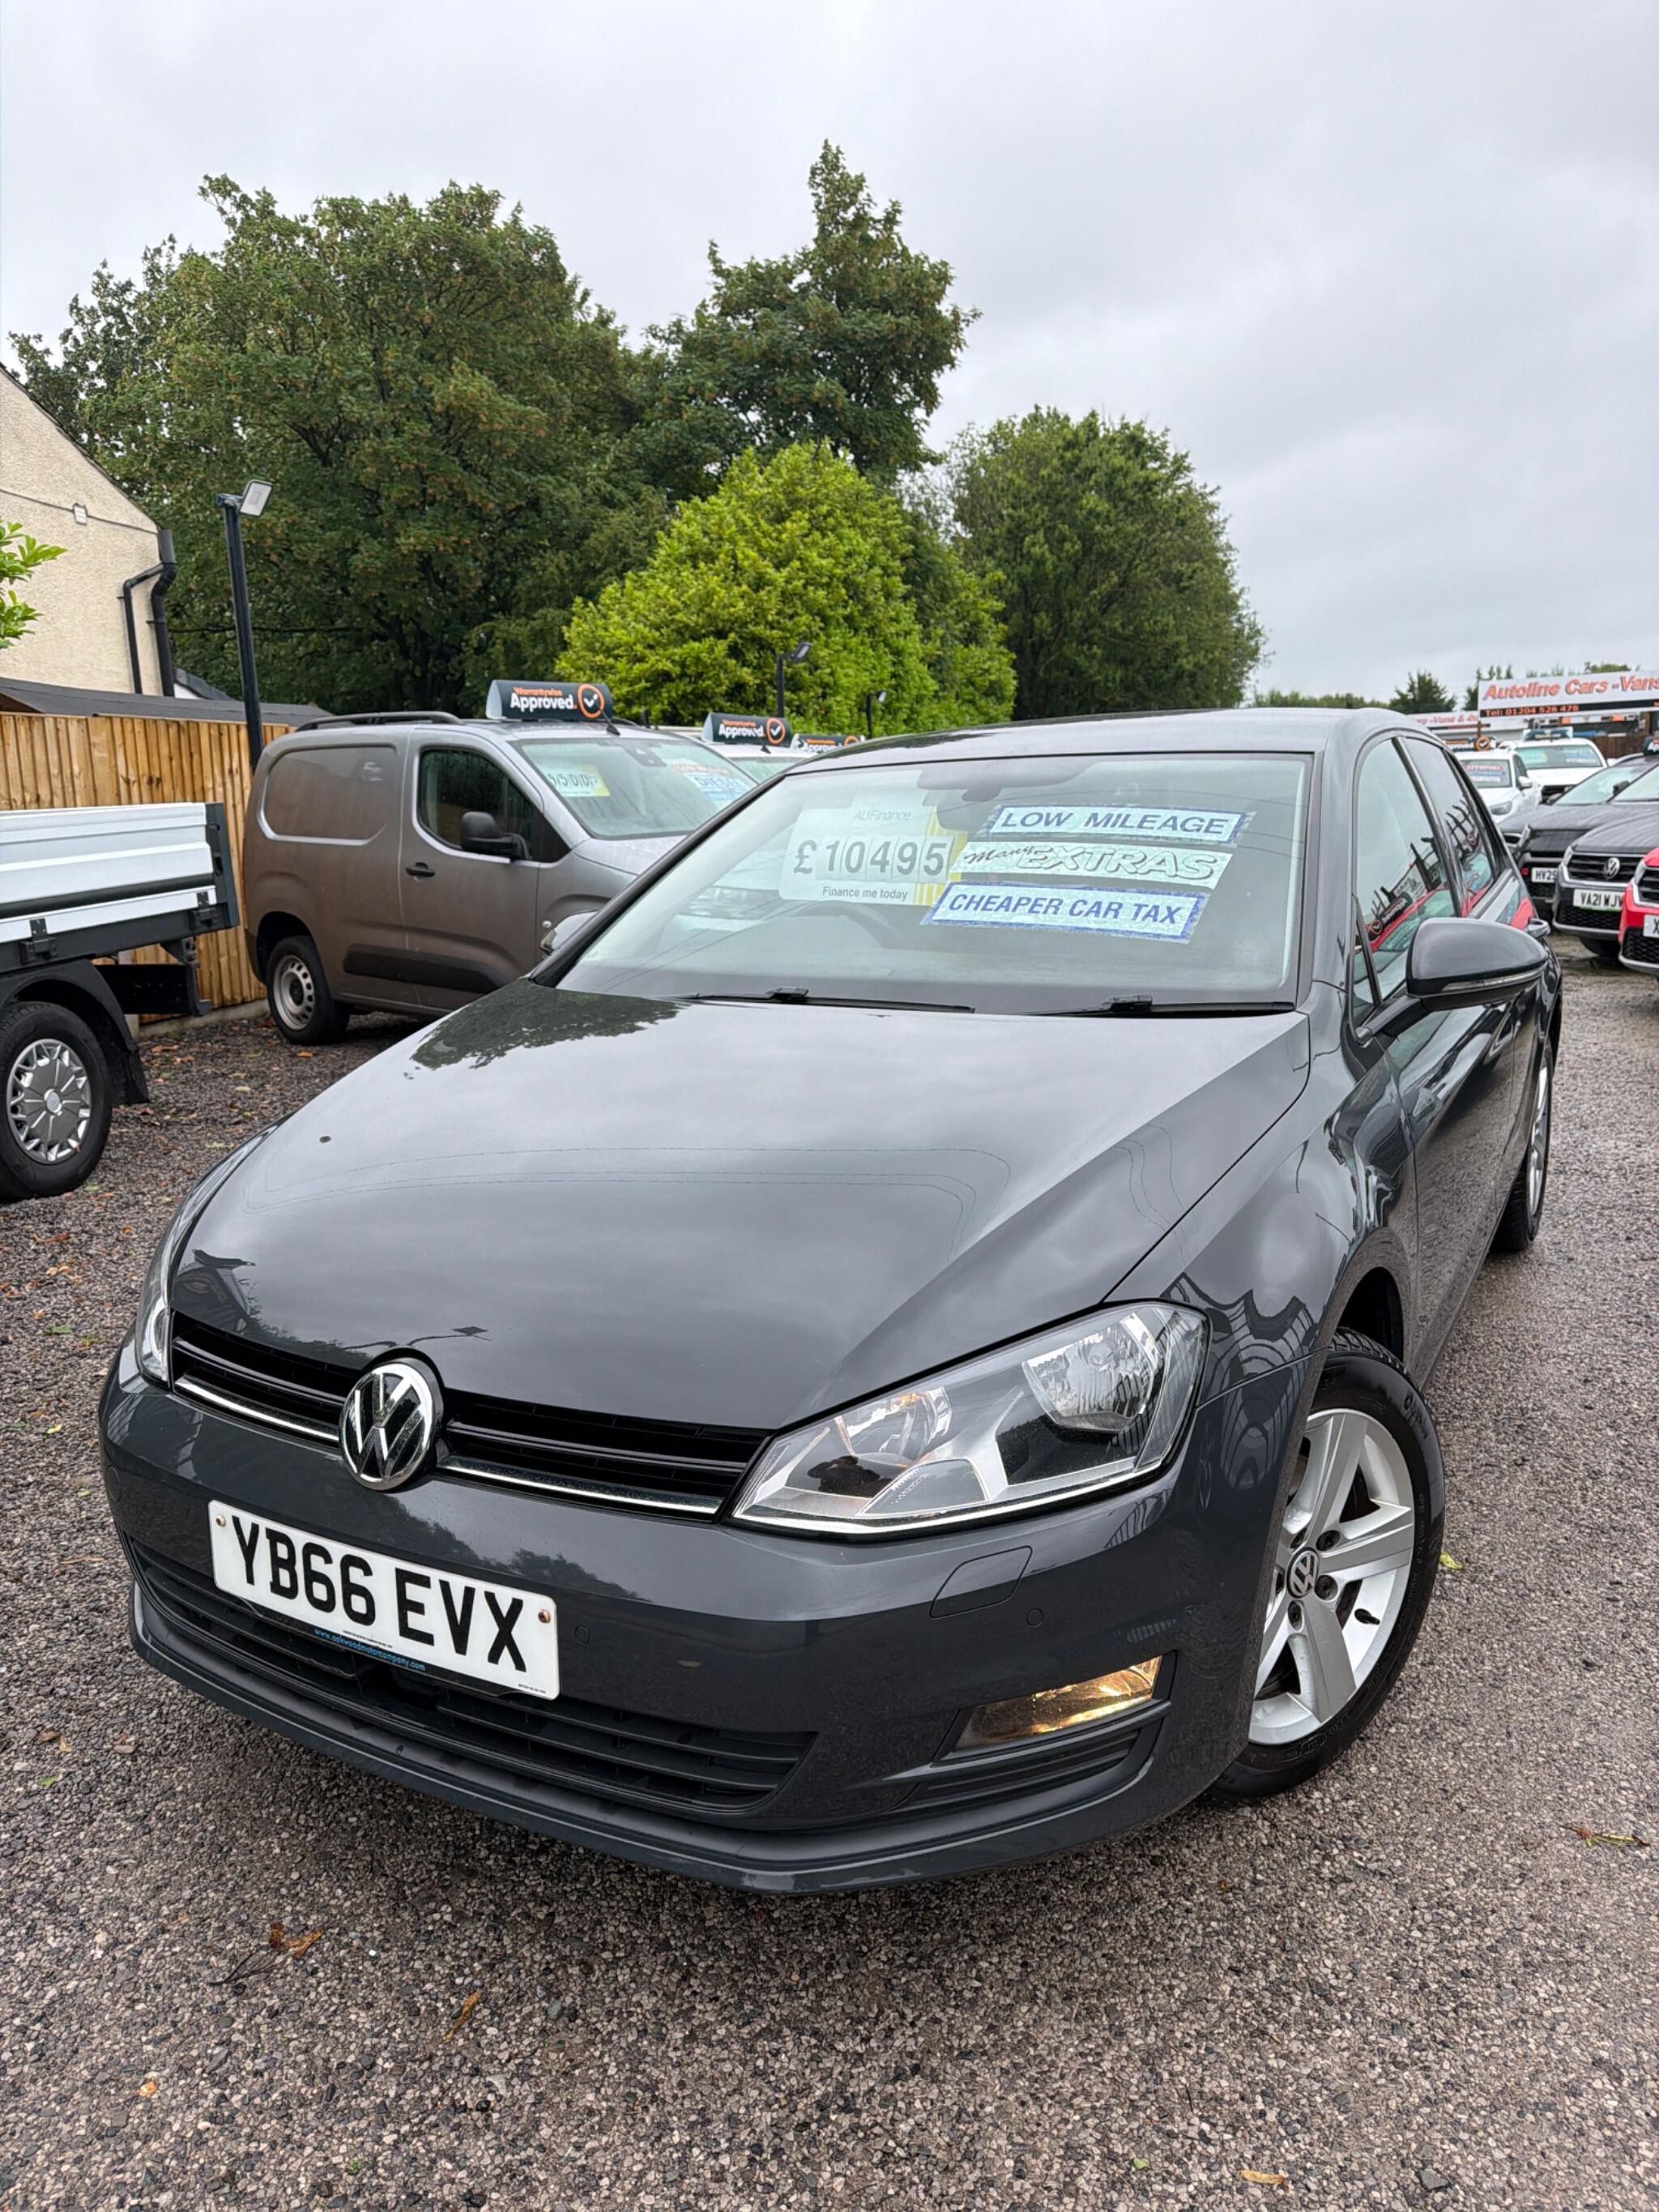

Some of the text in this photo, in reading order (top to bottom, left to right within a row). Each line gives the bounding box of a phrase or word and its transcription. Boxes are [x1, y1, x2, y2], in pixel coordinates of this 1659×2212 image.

[1482, 682, 1560, 700] Autoline
[1565, 679, 1608, 695] Cars
[1001, 812, 1228, 834] LOW MILEAGE
[793, 840, 947, 875] £10495
[963, 845, 1218, 880] Many EXTRAS
[822, 886, 907, 901] Finance me today
[1580, 893, 1601, 907] VA21
[949, 894, 1185, 924] CHEAPER CAR TAX
[232, 1515, 527, 1672] YB66 EVX
